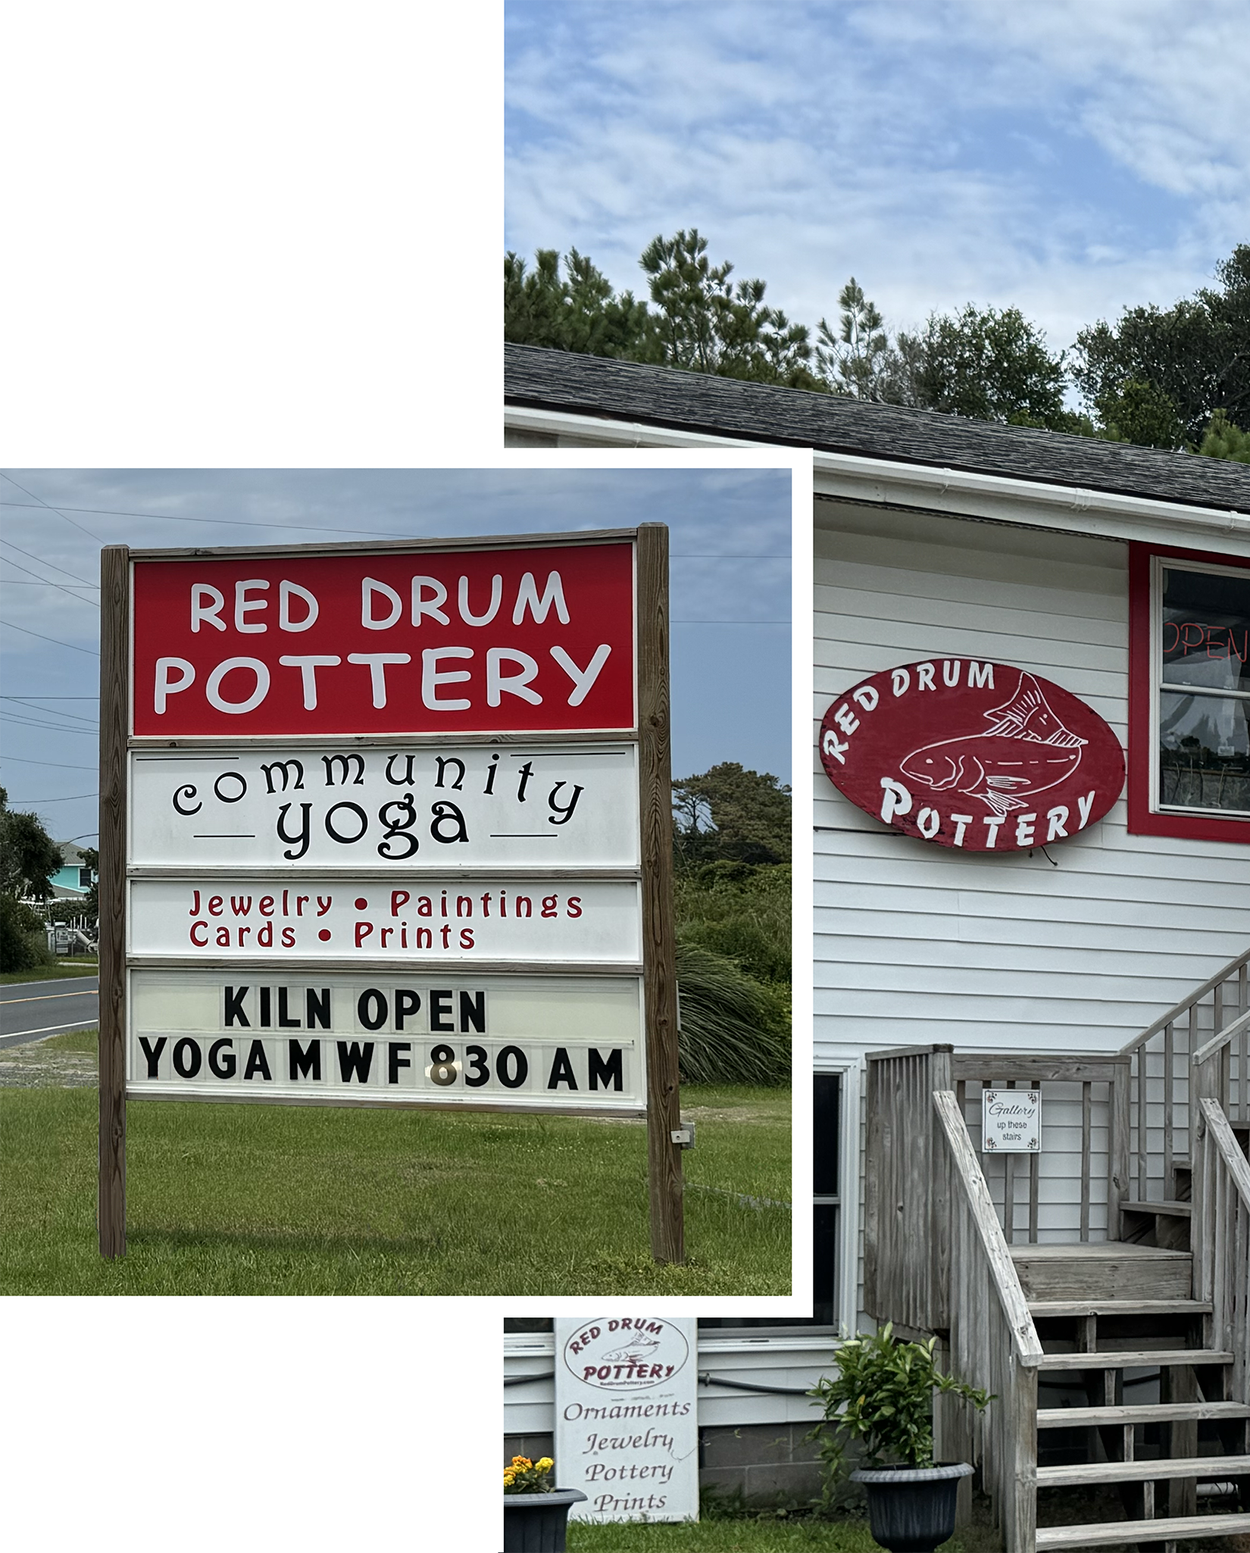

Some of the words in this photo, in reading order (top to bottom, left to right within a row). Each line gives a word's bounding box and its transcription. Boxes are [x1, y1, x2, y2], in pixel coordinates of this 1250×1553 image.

[190, 578, 320, 634] RED
[361, 570, 571, 631] DRUM
[1163, 622, 1248, 663] OPEN
[152, 644, 612, 714] POTTERY
[823, 685, 880, 764] RED
[891, 660, 995, 698] DRUM
[172, 752, 584, 825] community
[276, 793, 470, 861] yoga
[880, 776, 1096, 849] POTTERY
[189, 889, 333, 918] Jewelry
[390, 889, 583, 919] Paintings
[190, 920, 296, 947] Cards
[354, 921, 476, 950] Prints
[223, 985, 332, 1030] KILN
[357, 987, 486, 1033] OPEN
[138, 1036, 272, 1081] YOGA
[428, 1043, 528, 1089] 830
[548, 1047, 624, 1092] AM
[988, 1102, 1036, 1119] Gallery
[997, 1121, 1006, 1130] up
[1008, 1121, 1027, 1129] these
[1002, 1132, 1022, 1141] stairs
[569, 1326, 601, 1355] RED
[608, 1317, 664, 1335] DRUM
[583, 1363, 675, 1381] POTTERY
[563, 1401, 692, 1421] Ornaments
[582, 1428, 675, 1455] Jewelry
[585, 1462, 674, 1485] Pottery
[593, 1493, 667, 1513] Prints
